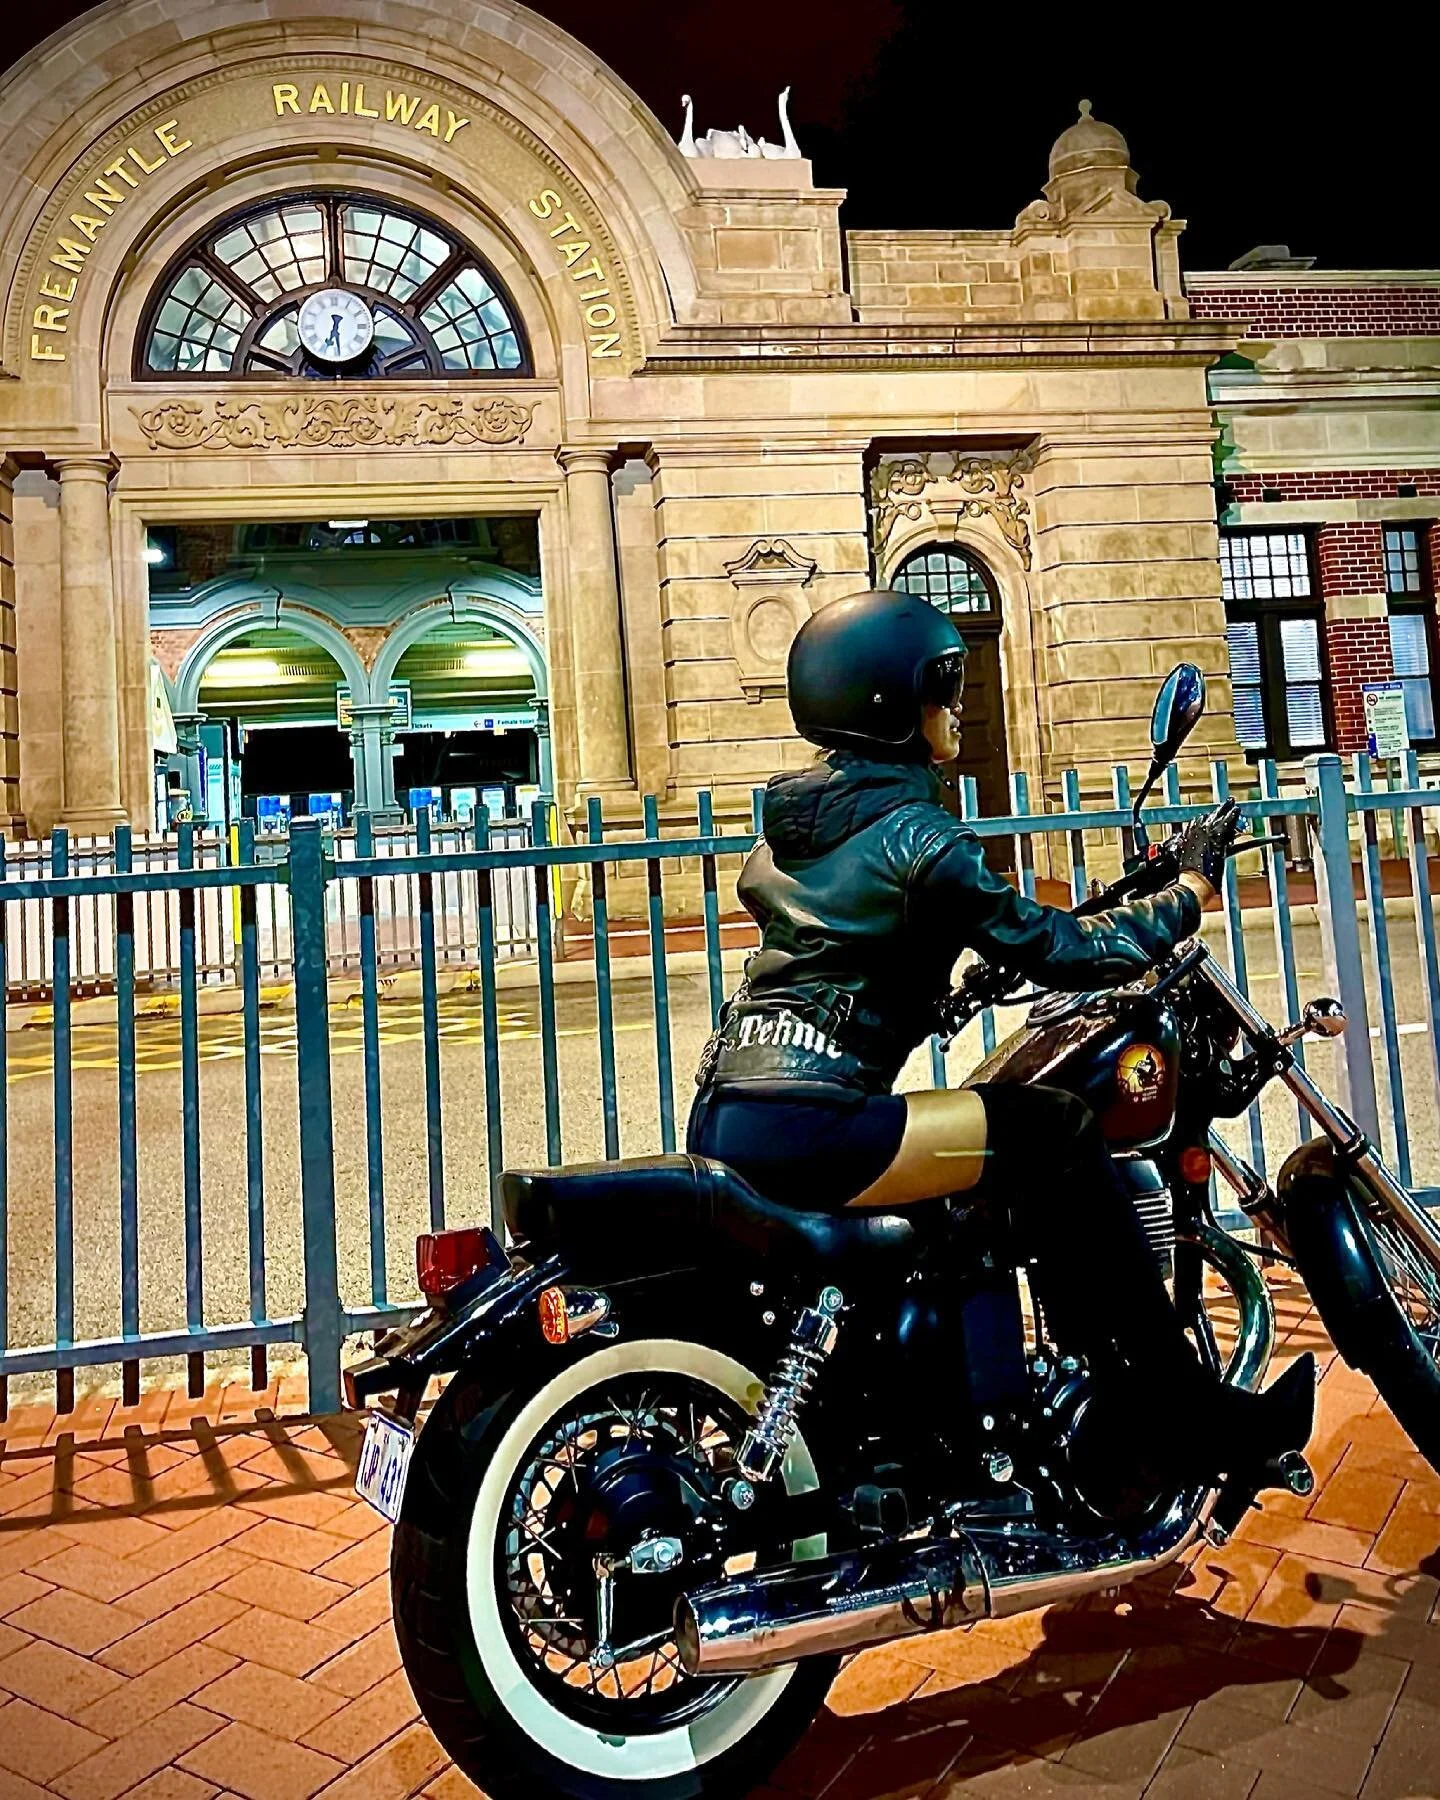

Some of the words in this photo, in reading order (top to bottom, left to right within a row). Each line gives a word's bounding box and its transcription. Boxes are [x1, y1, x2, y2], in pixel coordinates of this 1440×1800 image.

[30, 118, 194, 362] FREMANTLE
[271, 82, 471, 143] RAILWAY
[528, 189, 623, 359] STATION
